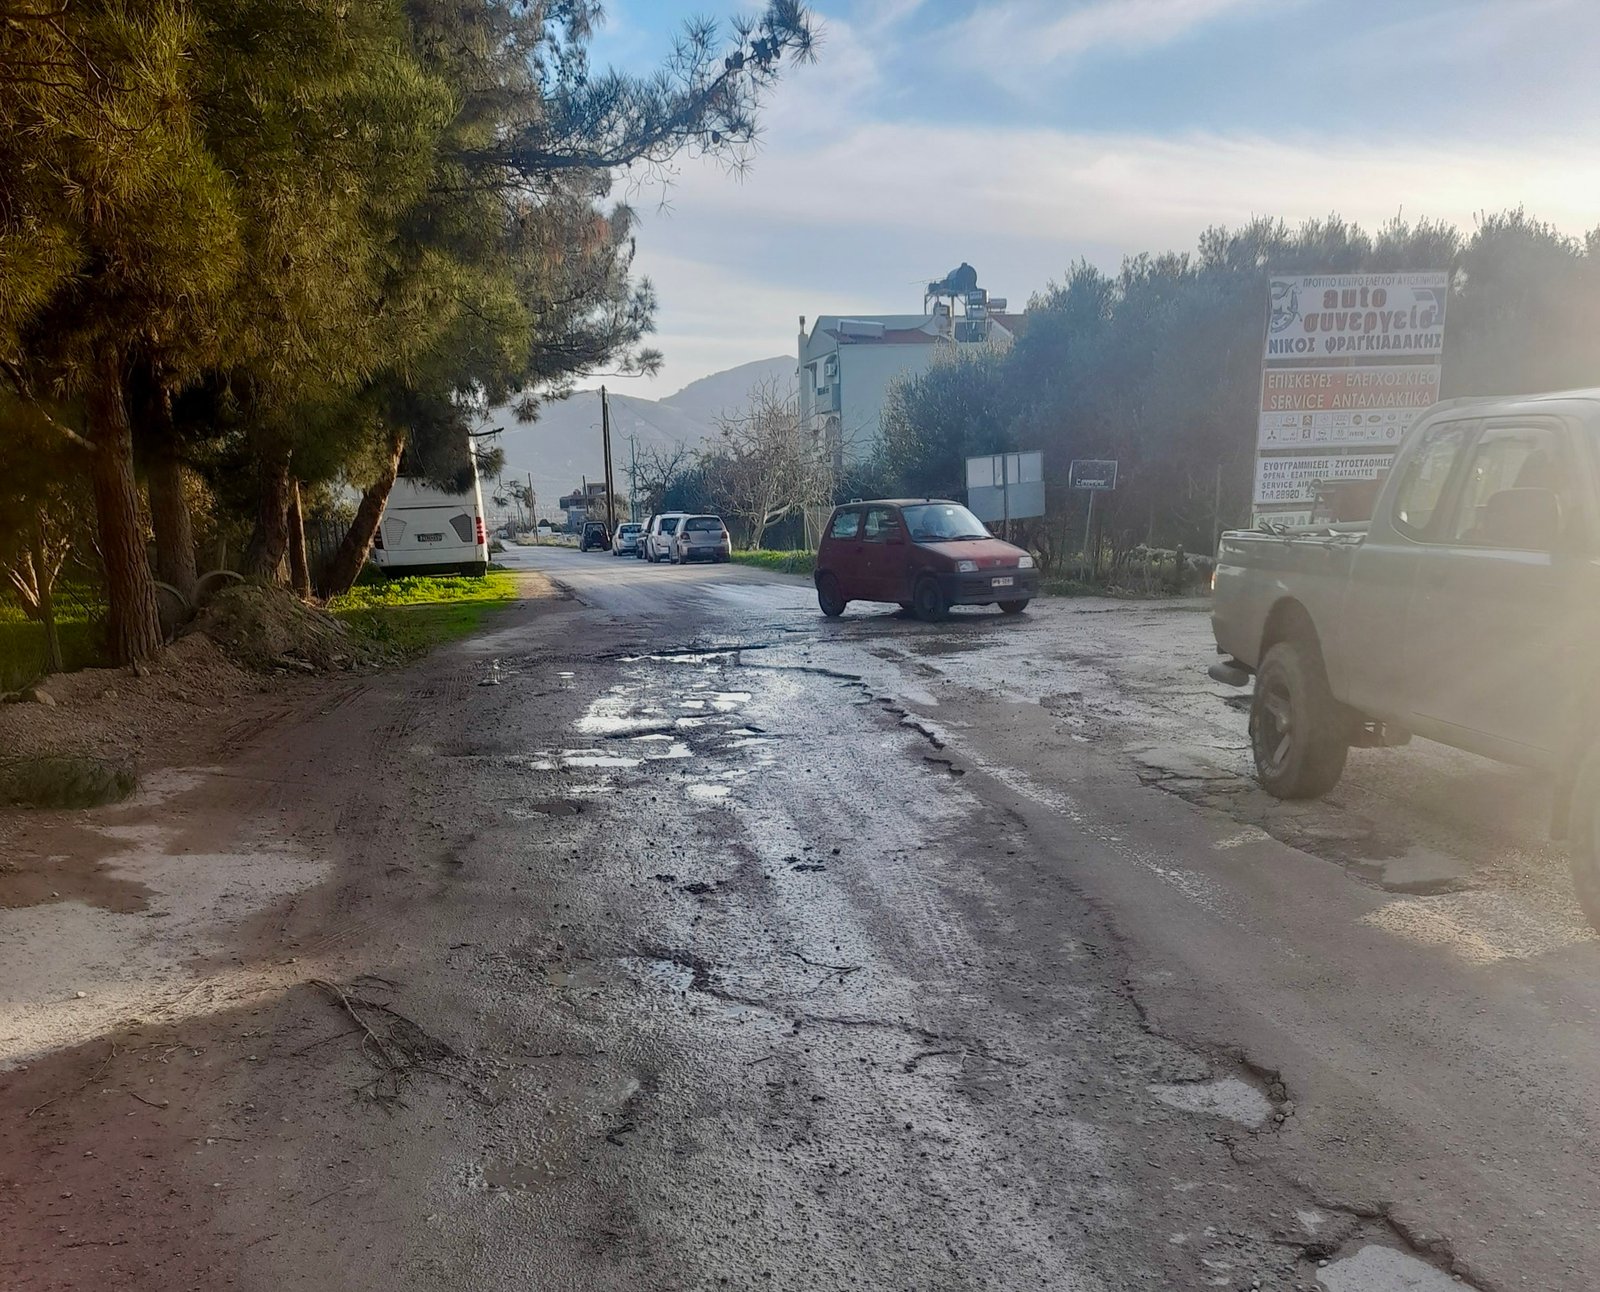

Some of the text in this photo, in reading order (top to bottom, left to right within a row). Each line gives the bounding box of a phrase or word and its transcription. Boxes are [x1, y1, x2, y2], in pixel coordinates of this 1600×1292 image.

[1323, 286, 1387, 309] auto
[1268, 333, 1441, 354] ΝΙΚΟΣ ΦΡΑΓΚΙΑΔΑΚΗΣ
[1268, 373, 1332, 389] ΕΠΙΣΚΕΥΕΣ
[1346, 372, 1403, 387] ΕΛΕΓΧΟΣ
[1407, 372, 1437, 386] ΚΤΕΟ
[1270, 392, 1431, 410] SERVICE ΑΝΤΑΛΛΑΚΤΙΚΑ
[1335, 458, 1393, 468] ΖΥΓΟΣΤΑΘΜΙΣΕ
[1263, 472, 1285, 480] ΦΡΕΝΑ
[1335, 469, 1373, 477] ΚΑΤΑΛΥΤΕΣ
[1262, 481, 1293, 490] SERVICE
